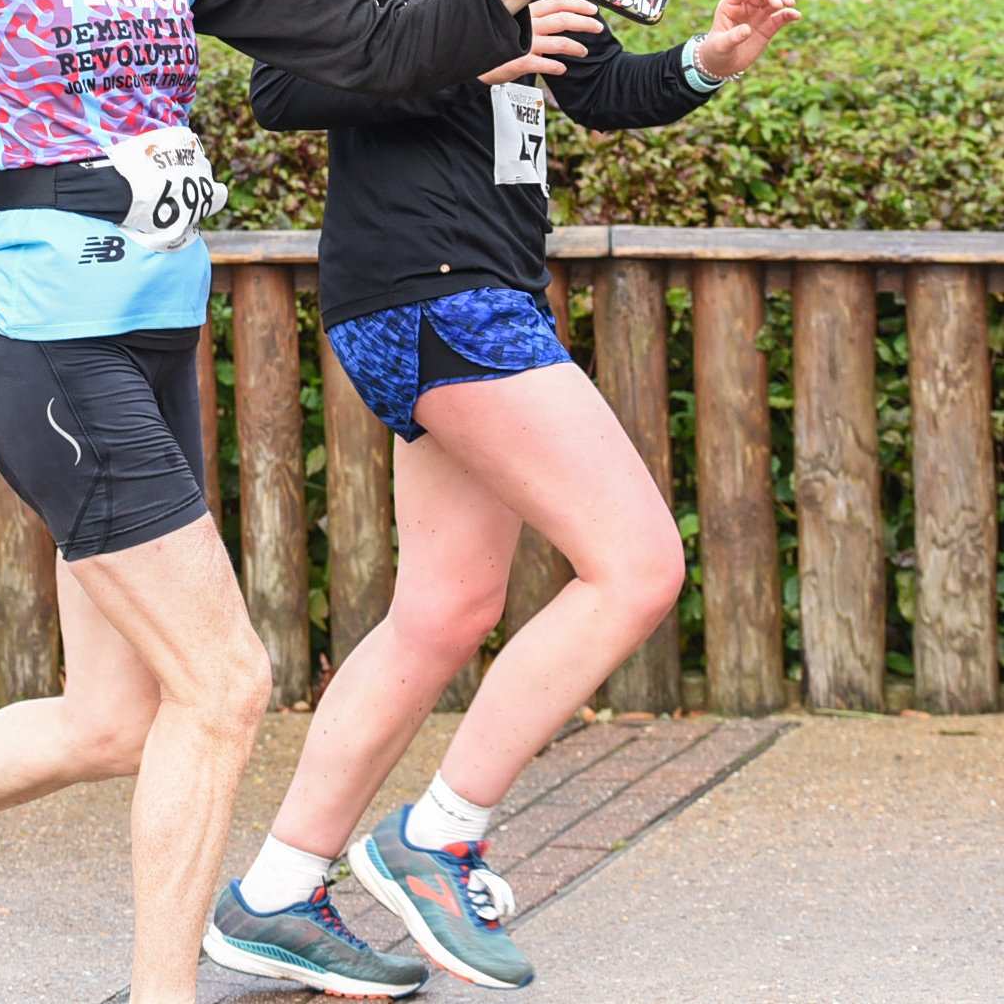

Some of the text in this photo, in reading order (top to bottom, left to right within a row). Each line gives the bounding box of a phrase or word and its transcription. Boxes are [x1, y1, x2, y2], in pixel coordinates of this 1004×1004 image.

[51, 18, 192, 48] DEMENTIA
[56, 43, 199, 76] REVOLUTIO
[152, 176, 214, 229] 698
